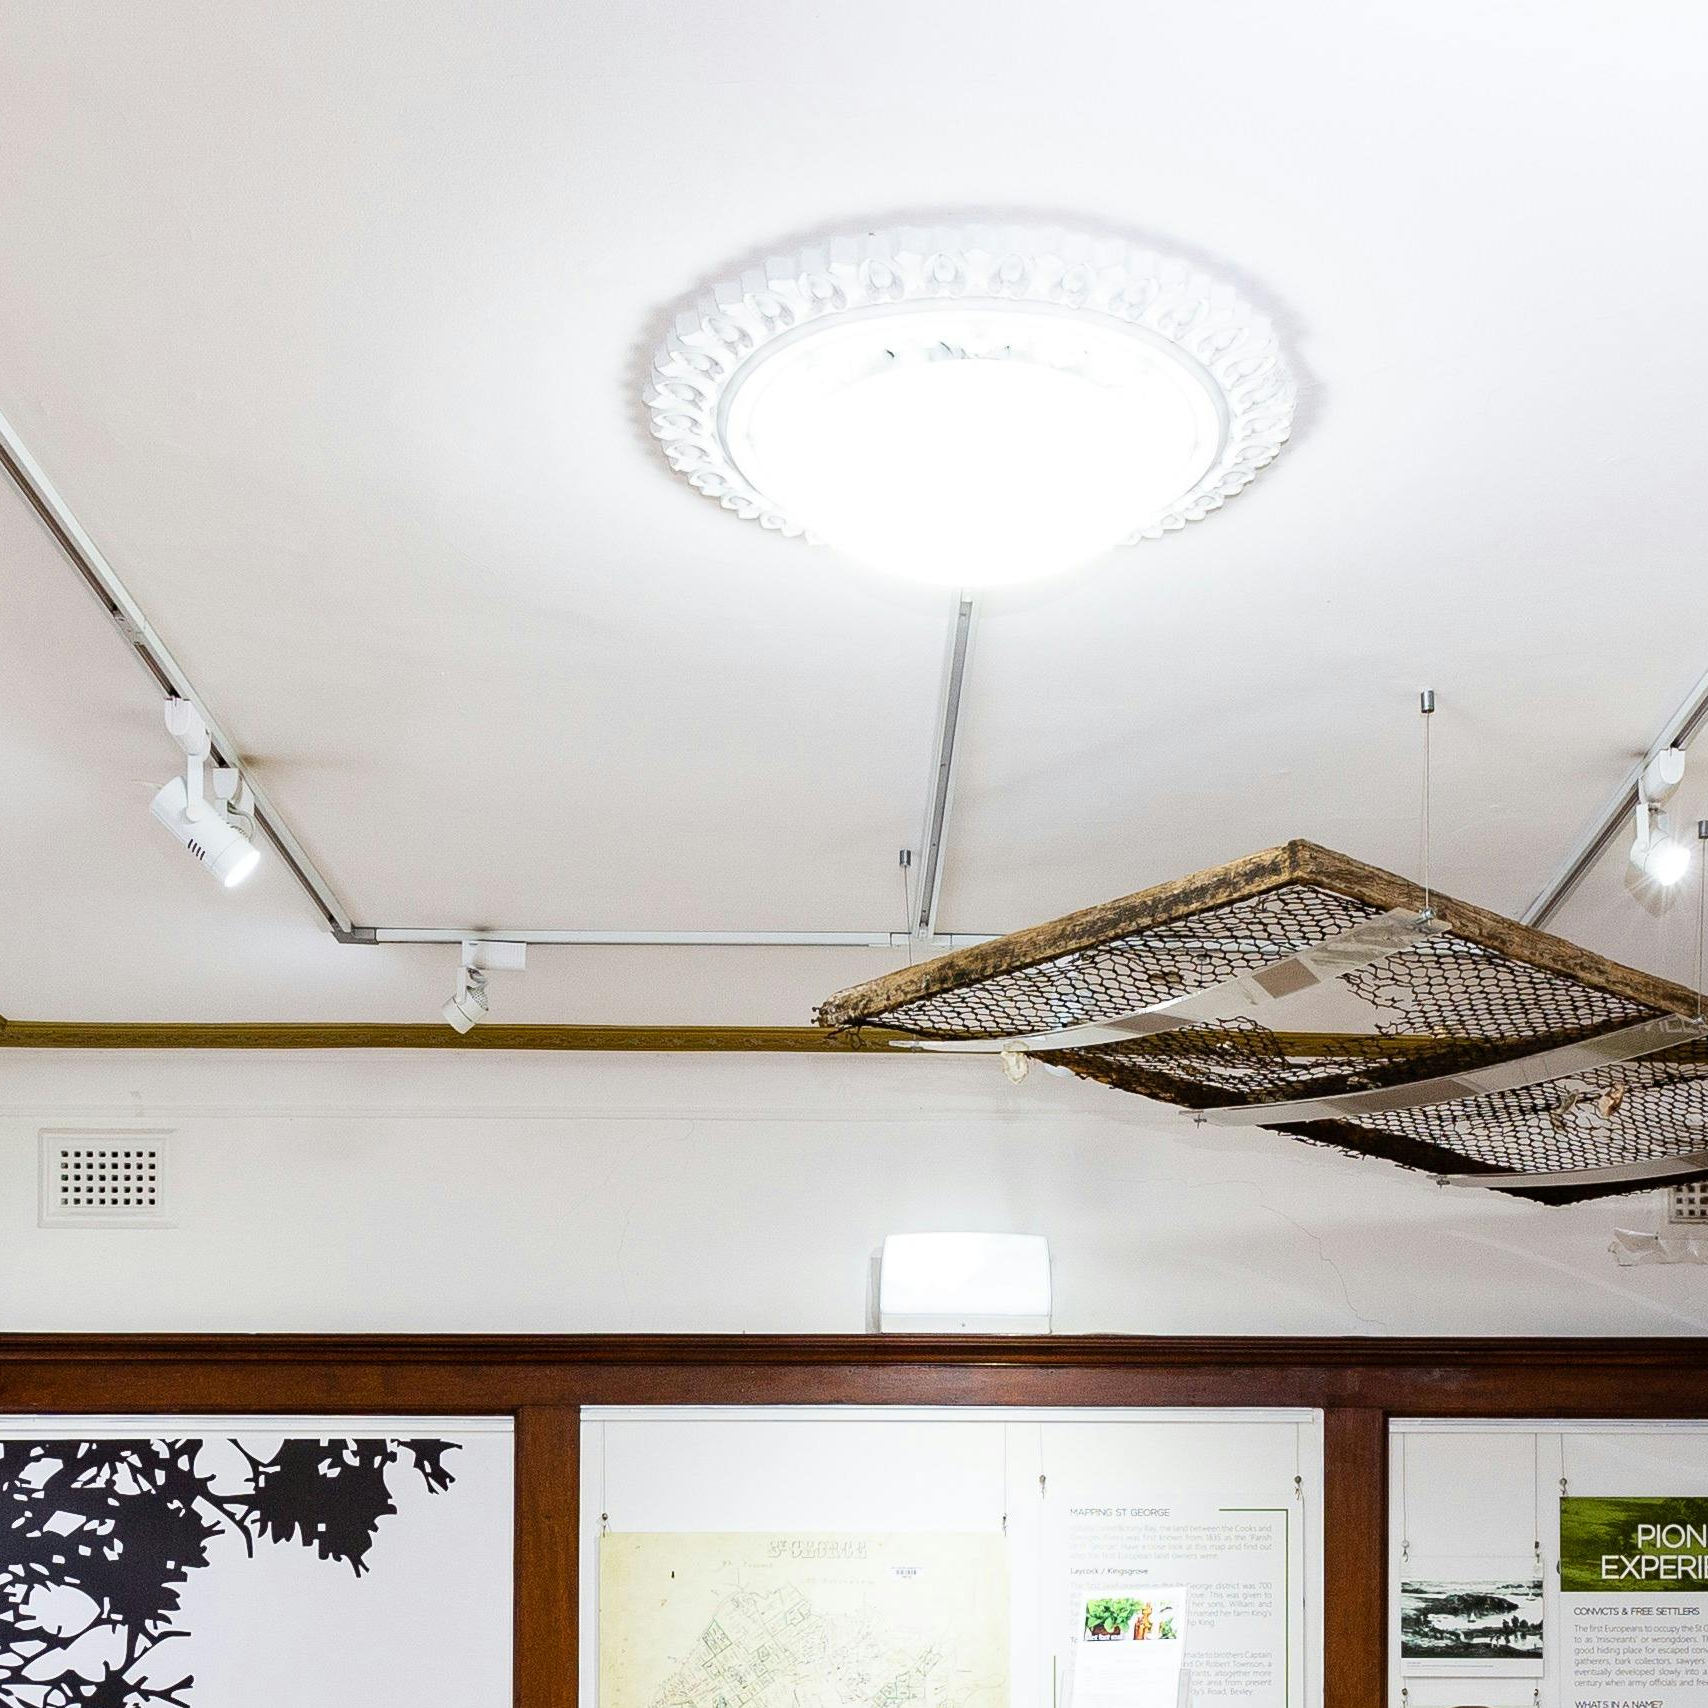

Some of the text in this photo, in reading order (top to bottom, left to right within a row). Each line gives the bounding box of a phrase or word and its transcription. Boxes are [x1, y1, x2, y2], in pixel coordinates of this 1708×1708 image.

[1573, 1606, 1620, 1617] CONVICTS
[1630, 1606, 1655, 1617] FREE
[1656, 1606, 1701, 1617] SETTLERS
